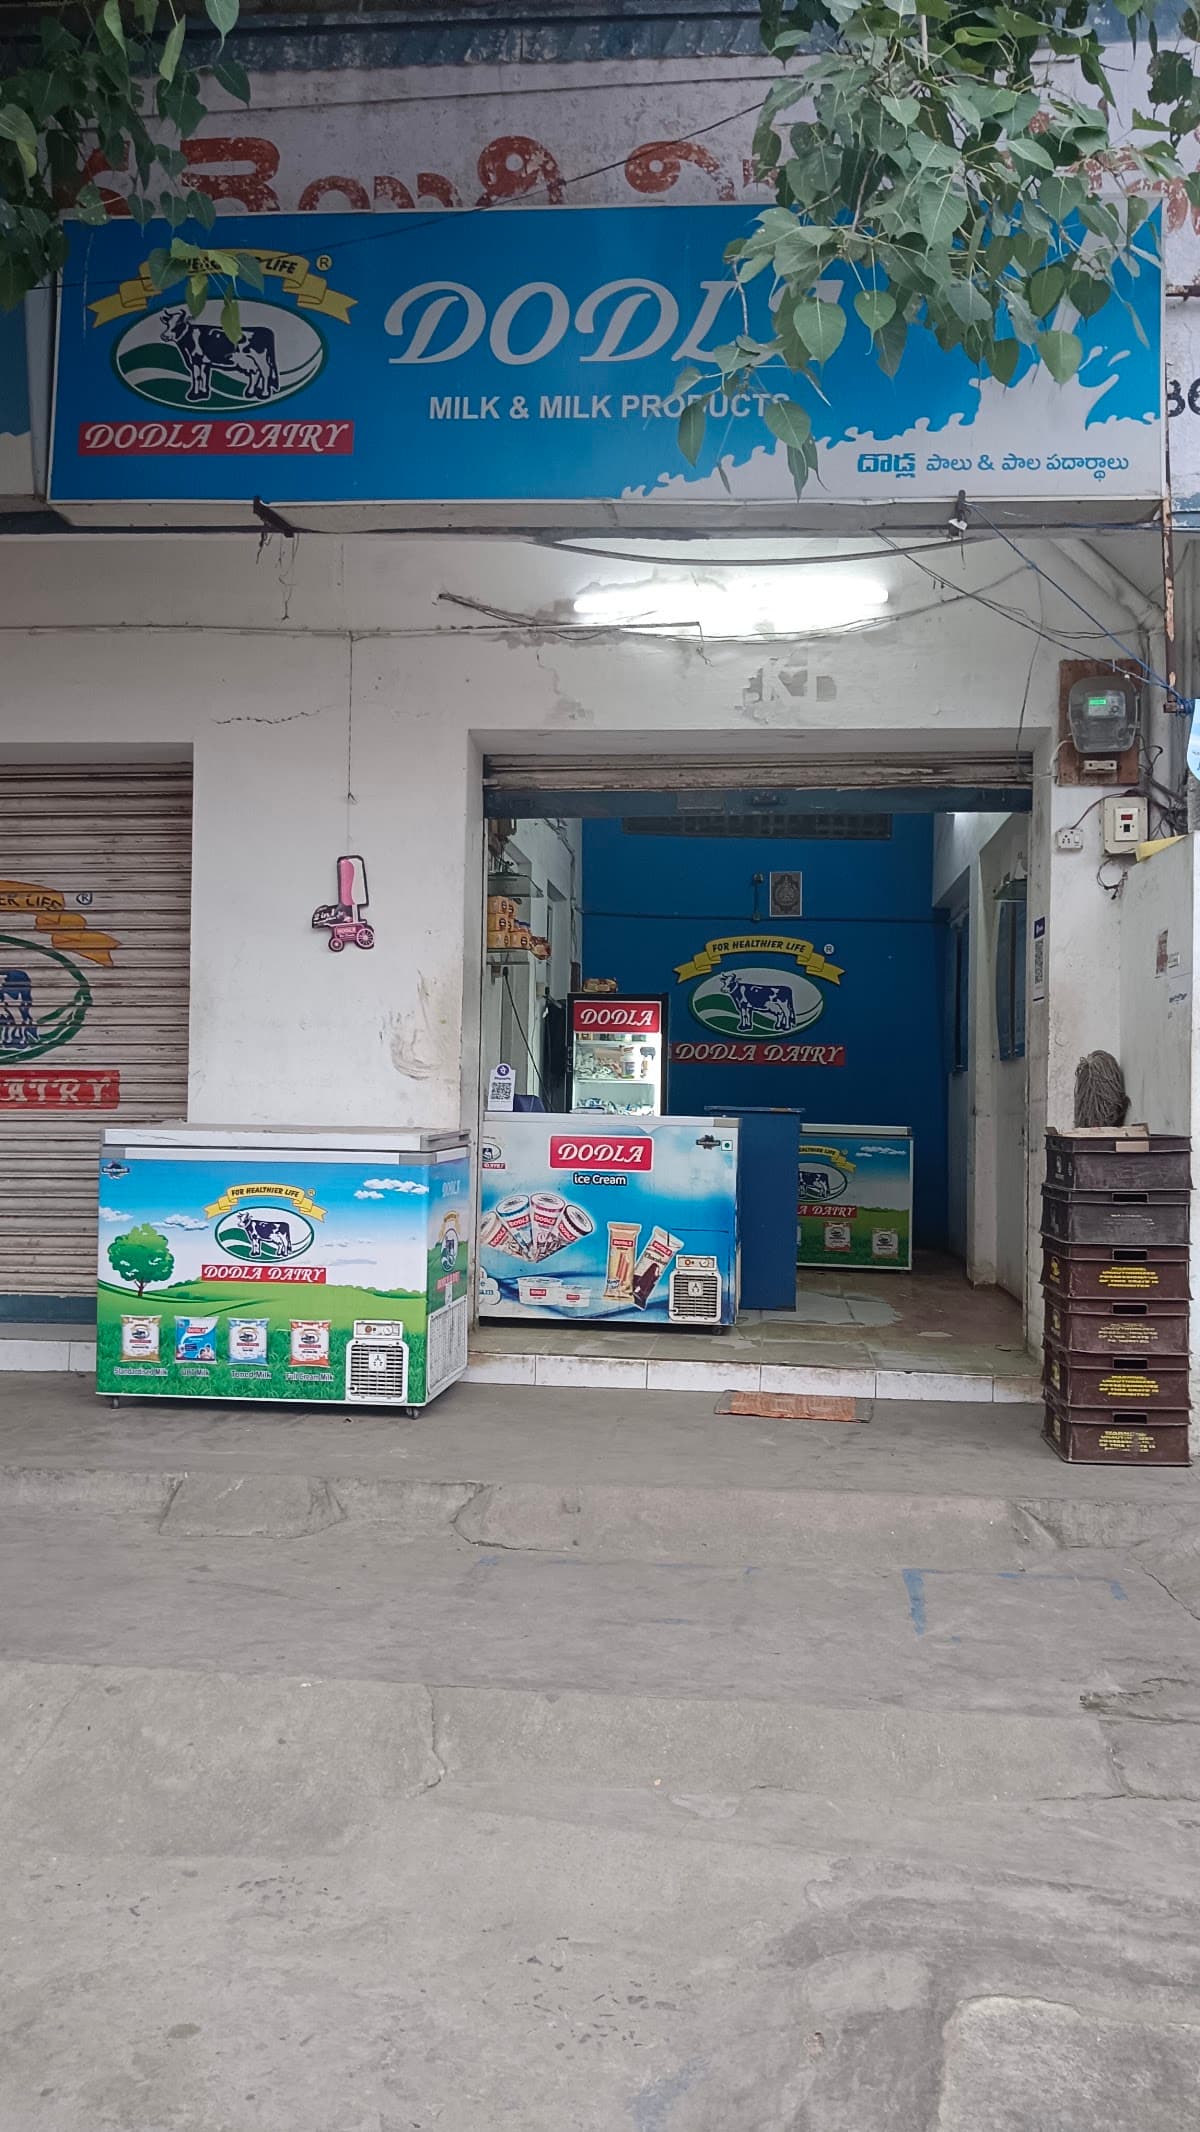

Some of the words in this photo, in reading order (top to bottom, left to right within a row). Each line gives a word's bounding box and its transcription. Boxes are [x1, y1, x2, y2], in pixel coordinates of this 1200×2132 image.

[265, 259, 299, 274] LIFE
[429, 396, 500, 419] MILK
[510, 395, 529, 419] &
[548, 395, 615, 418] MILK
[85, 424, 211, 449] DODLA
[224, 423, 349, 452] DAIRY
[926, 454, 972, 471] పాలు
[978, 455, 995, 470] &
[1001, 453, 1040, 471] పాల
[1046, 454, 1129, 482] పదార్థాలు
[712, 942, 729, 953] FOR
[733, 940, 784, 950] HEALTHIER
[786, 942, 807, 953] LIFE
[581, 1008, 654, 1026] DODLA
[675, 1043, 756, 1061] DODLA
[764, 1045, 843, 1064] DAIRY
[558, 1143, 644, 1163] DODLA
[592, 1174, 626, 1185] Cream
[232, 1188, 245, 1197] FOR
[246, 1187, 282, 1195] HEALTHIER
[285, 1189, 300, 1198] LIFE
[812, 1206, 856, 1218] DAIRY
[204, 1265, 262, 1280] DODLA
[267, 1267, 325, 1283] DAIRY
[256, 1371, 271, 1379] Milk
